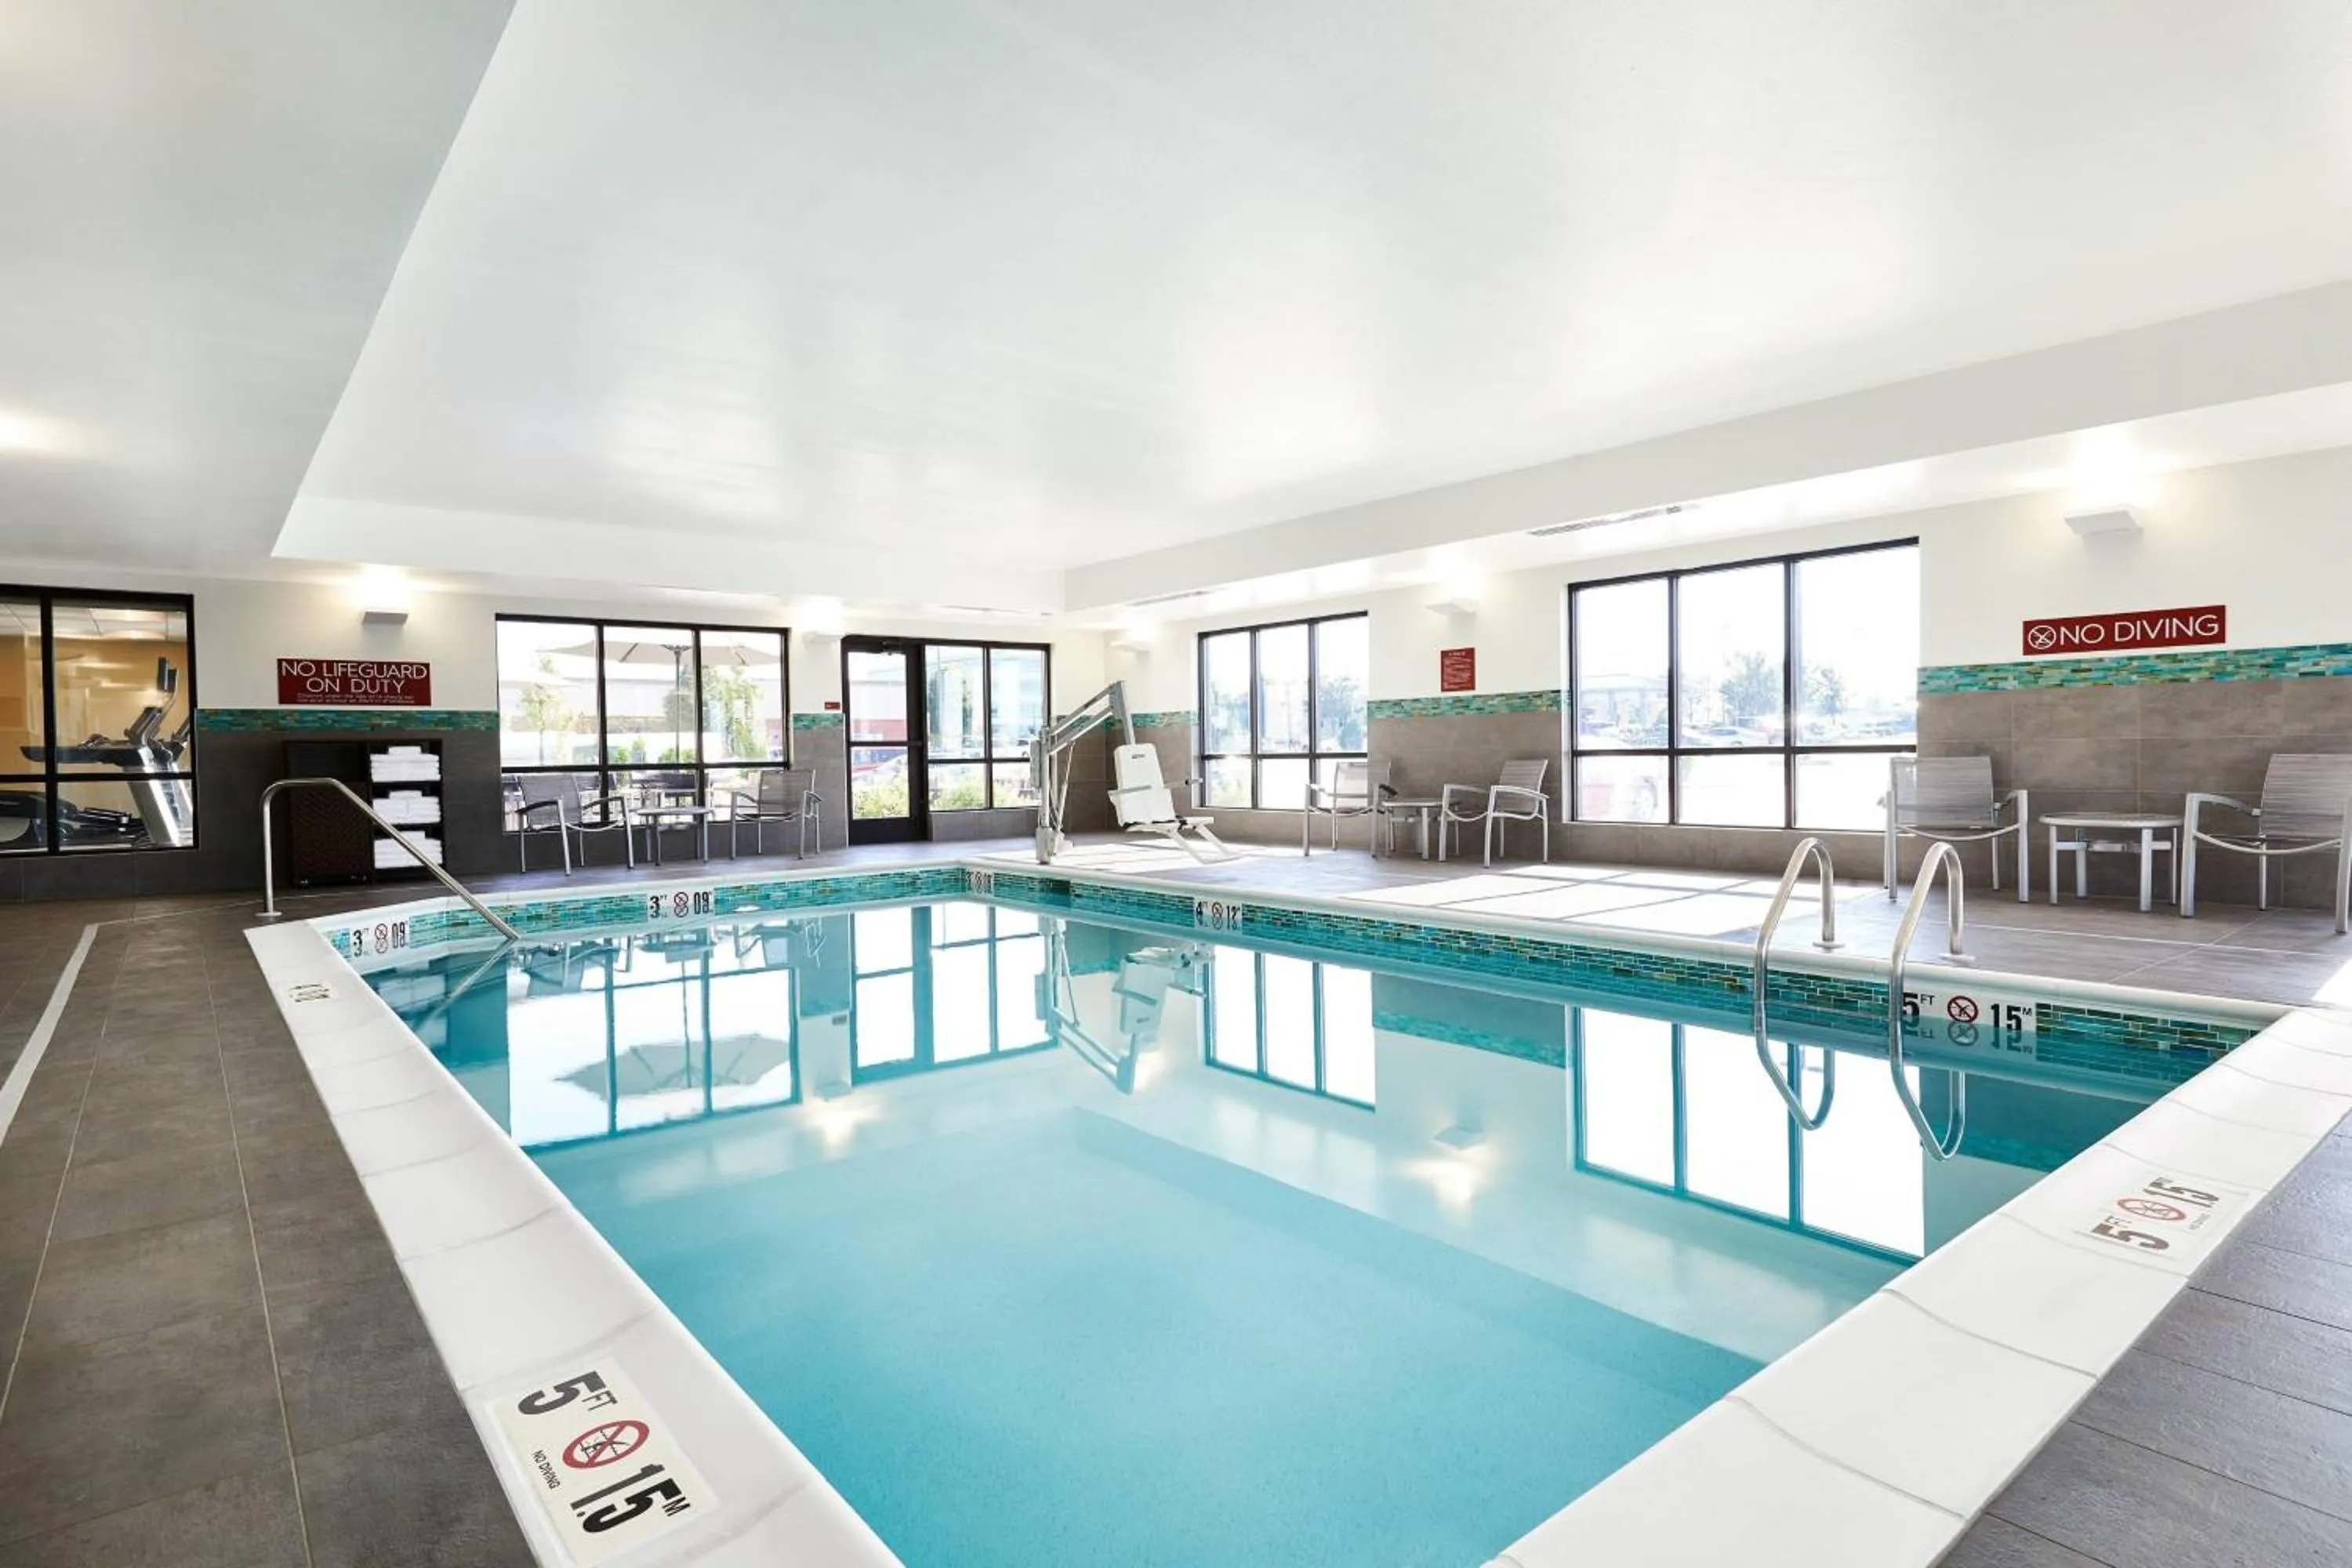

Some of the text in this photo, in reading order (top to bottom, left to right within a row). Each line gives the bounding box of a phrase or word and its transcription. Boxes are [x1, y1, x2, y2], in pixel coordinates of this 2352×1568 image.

[2060, 615, 2220, 645] NO DIVING
[281, 661, 427, 679] NO LIFEGUARD
[307, 677, 405, 693] ON DUTY
[532, 1450, 561, 1490] NO DIVING
